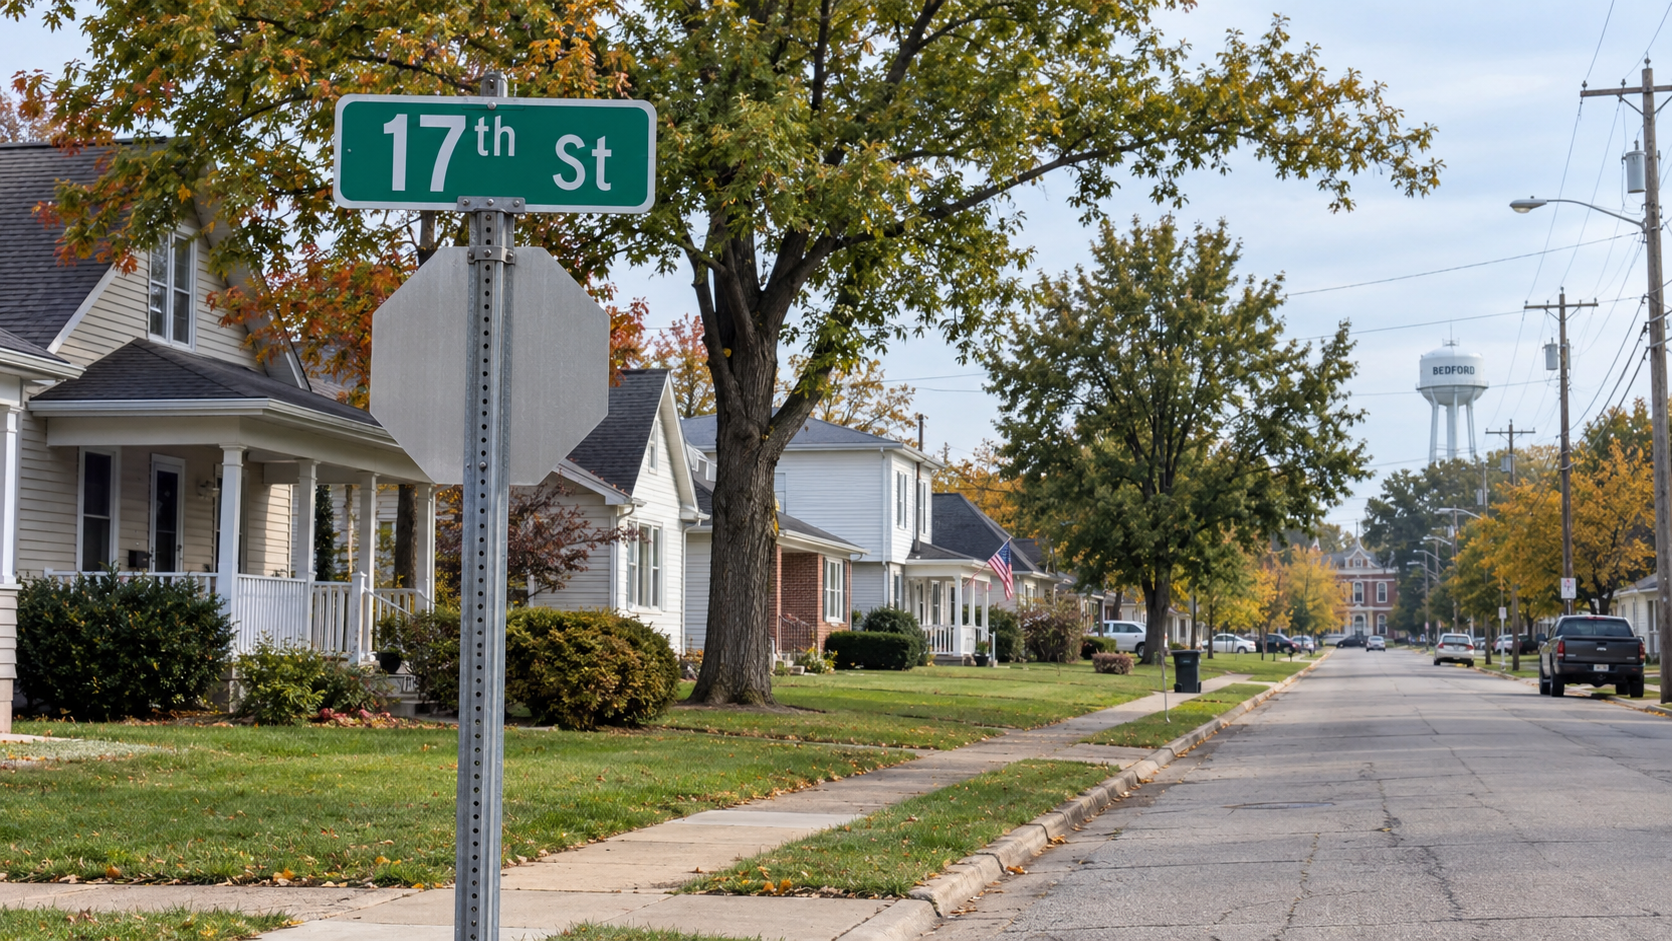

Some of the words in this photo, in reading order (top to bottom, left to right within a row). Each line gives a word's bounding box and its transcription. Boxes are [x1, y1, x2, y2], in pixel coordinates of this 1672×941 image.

[383, 113, 516, 192] 17th
[552, 134, 612, 191] St
[1432, 365, 1475, 376] BEDFORD
